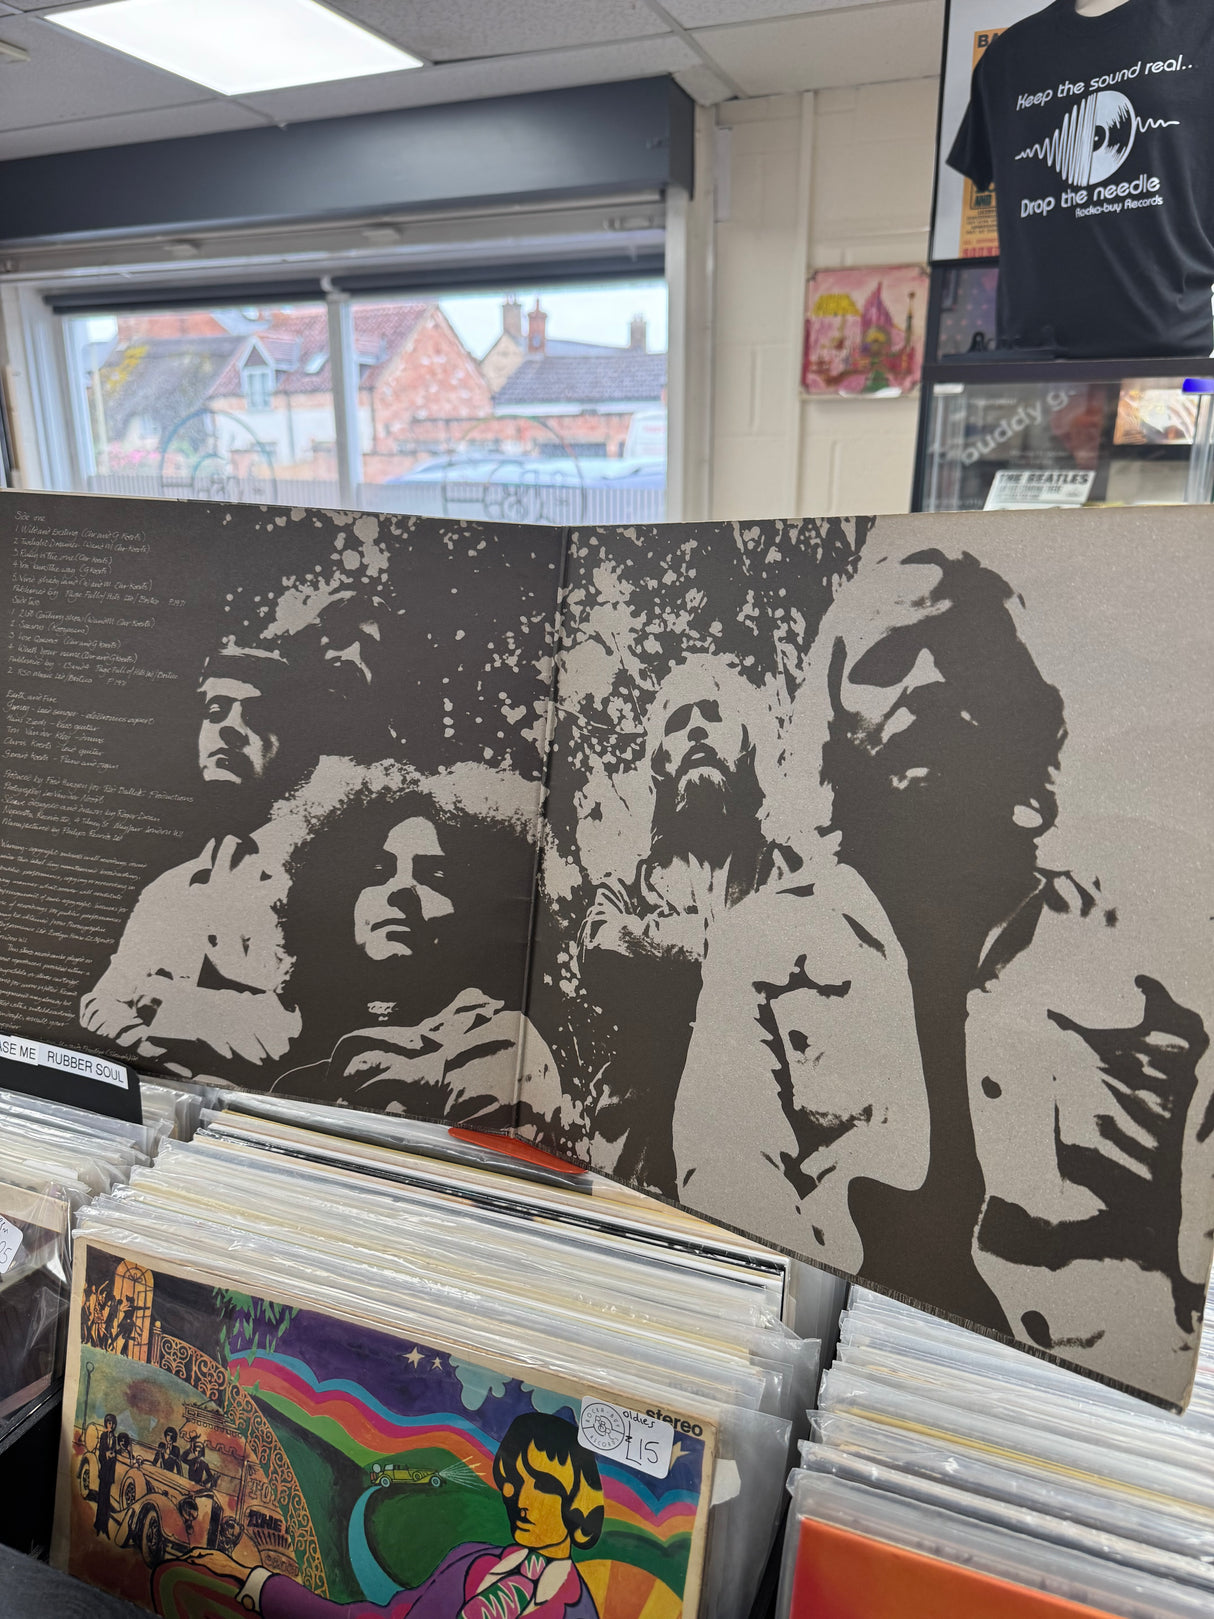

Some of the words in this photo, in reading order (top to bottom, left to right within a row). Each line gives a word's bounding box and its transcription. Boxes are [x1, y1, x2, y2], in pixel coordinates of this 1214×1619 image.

[1015, 88, 1053, 111] Keep
[1057, 80, 1086, 98] the
[1088, 61, 1142, 91] sound
[1020, 198, 1056, 218] Drop
[1061, 188, 1088, 208] the
[1093, 173, 1161, 201] needle
[1124, 195, 1164, 210] Records
[0, 1040, 17, 1056] SE
[19, 1045, 37, 1061] ME
[47, 1050, 93, 1074] RUBBER
[95, 1063, 125, 1084] SOUL
[645, 1409, 704, 1437] stereo
